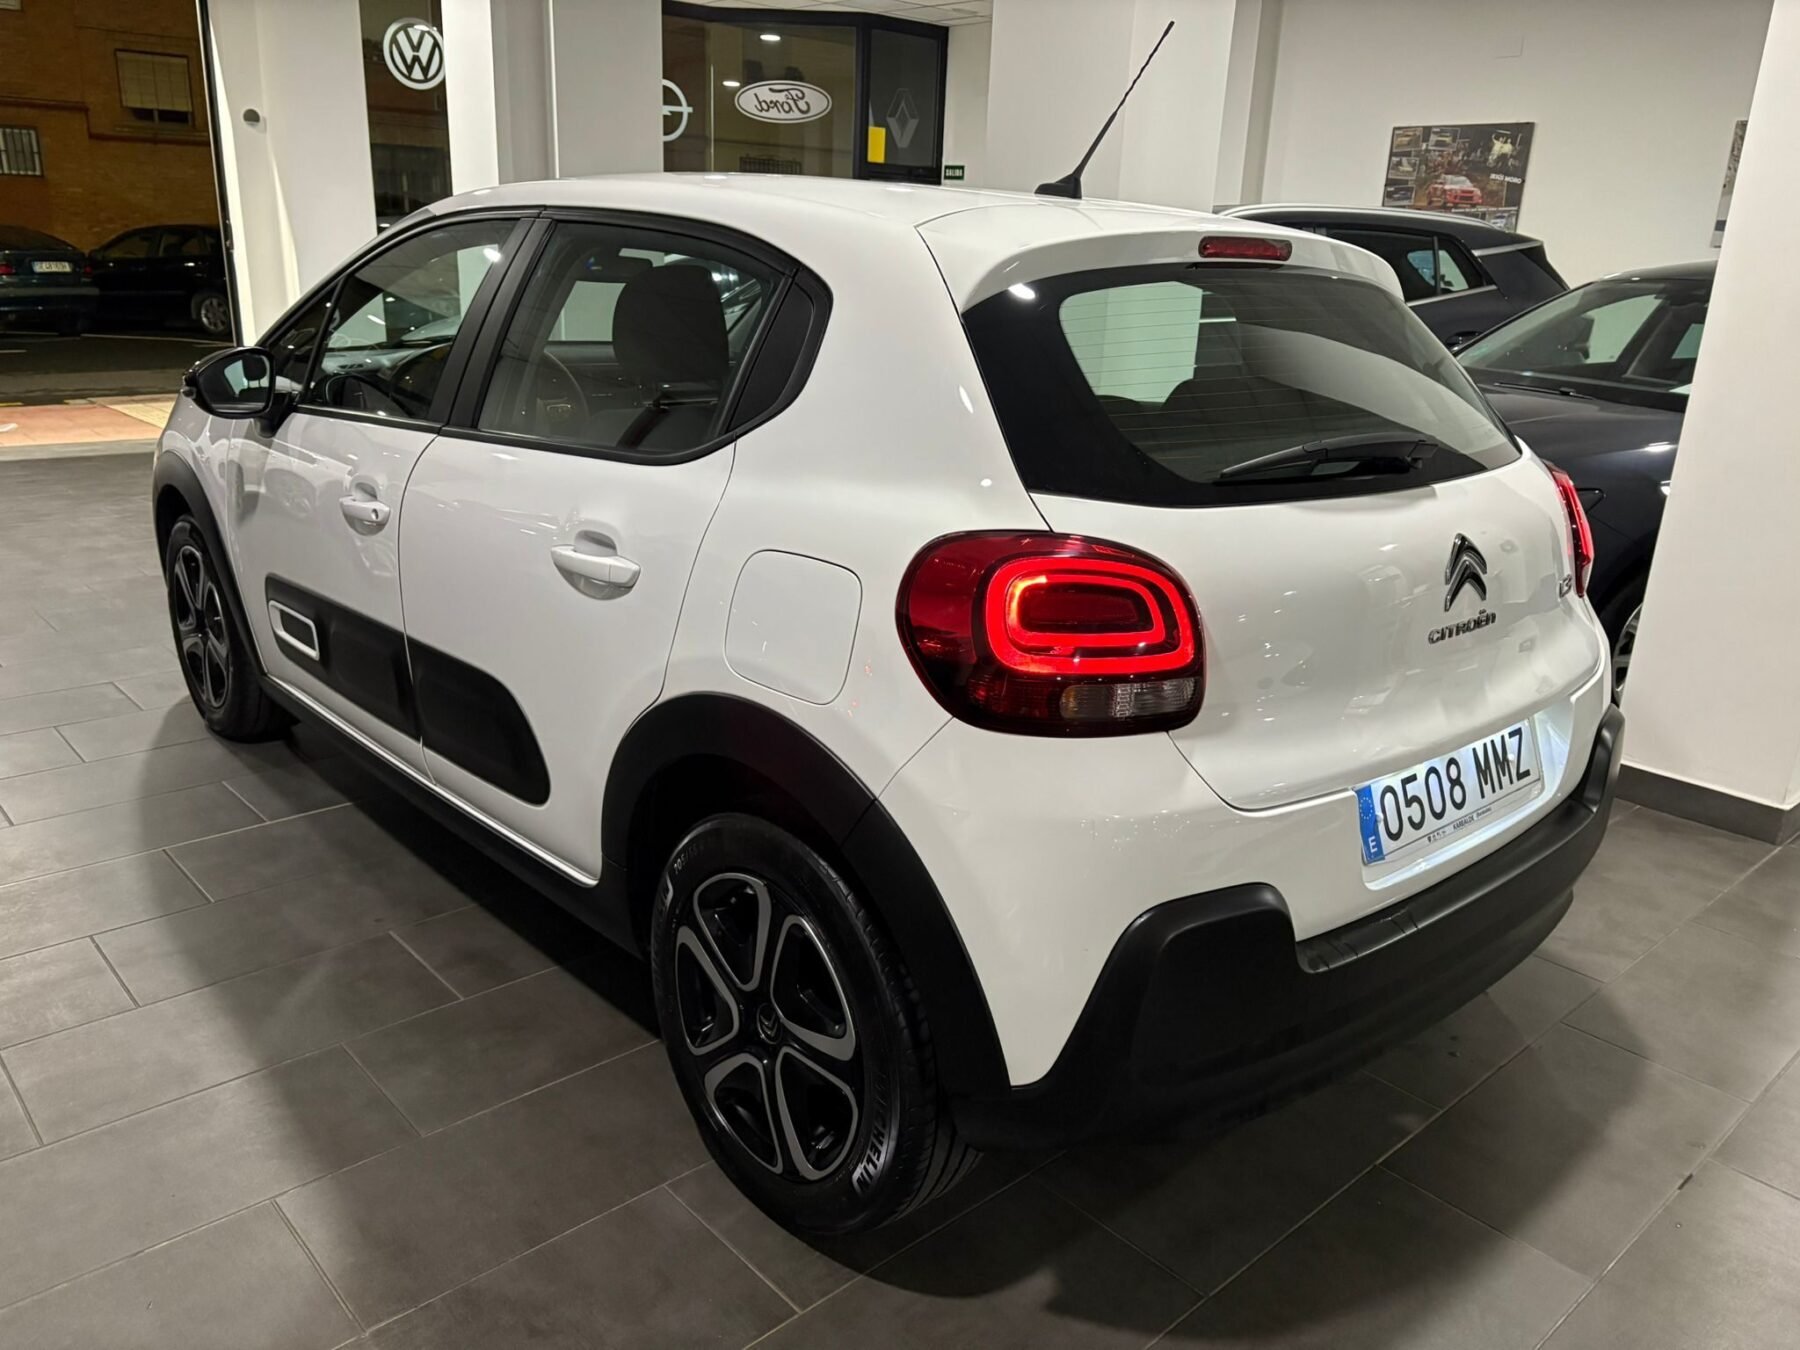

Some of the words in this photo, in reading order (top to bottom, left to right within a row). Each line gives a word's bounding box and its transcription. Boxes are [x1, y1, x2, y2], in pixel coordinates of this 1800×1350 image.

[389, 23, 443, 83] VW
[945, 168, 963, 177] SALIDA
[1379, 757, 1467, 842] 0508
[1473, 727, 1531, 799] MMZ
[1368, 836, 1379, 853] E
